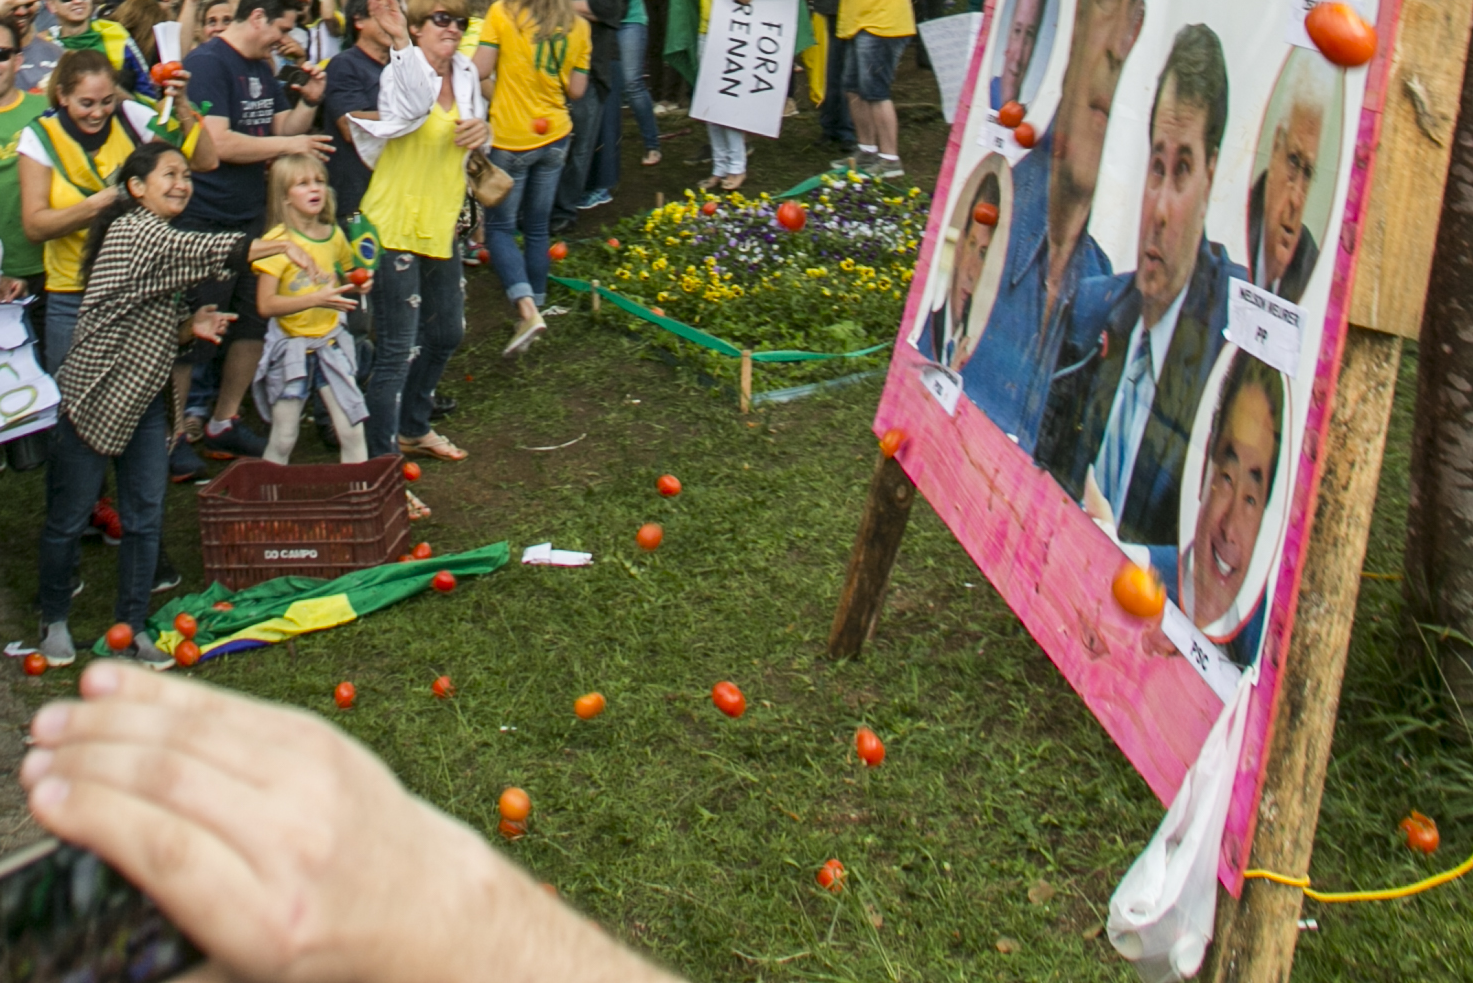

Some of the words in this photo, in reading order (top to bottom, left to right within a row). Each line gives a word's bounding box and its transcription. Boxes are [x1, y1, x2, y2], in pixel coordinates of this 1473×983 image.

[718, 0, 753, 98] RENAN
[750, 21, 783, 94] FORA
[264, 549, 279, 559] DO
[280, 549, 318, 559] CAMPO
